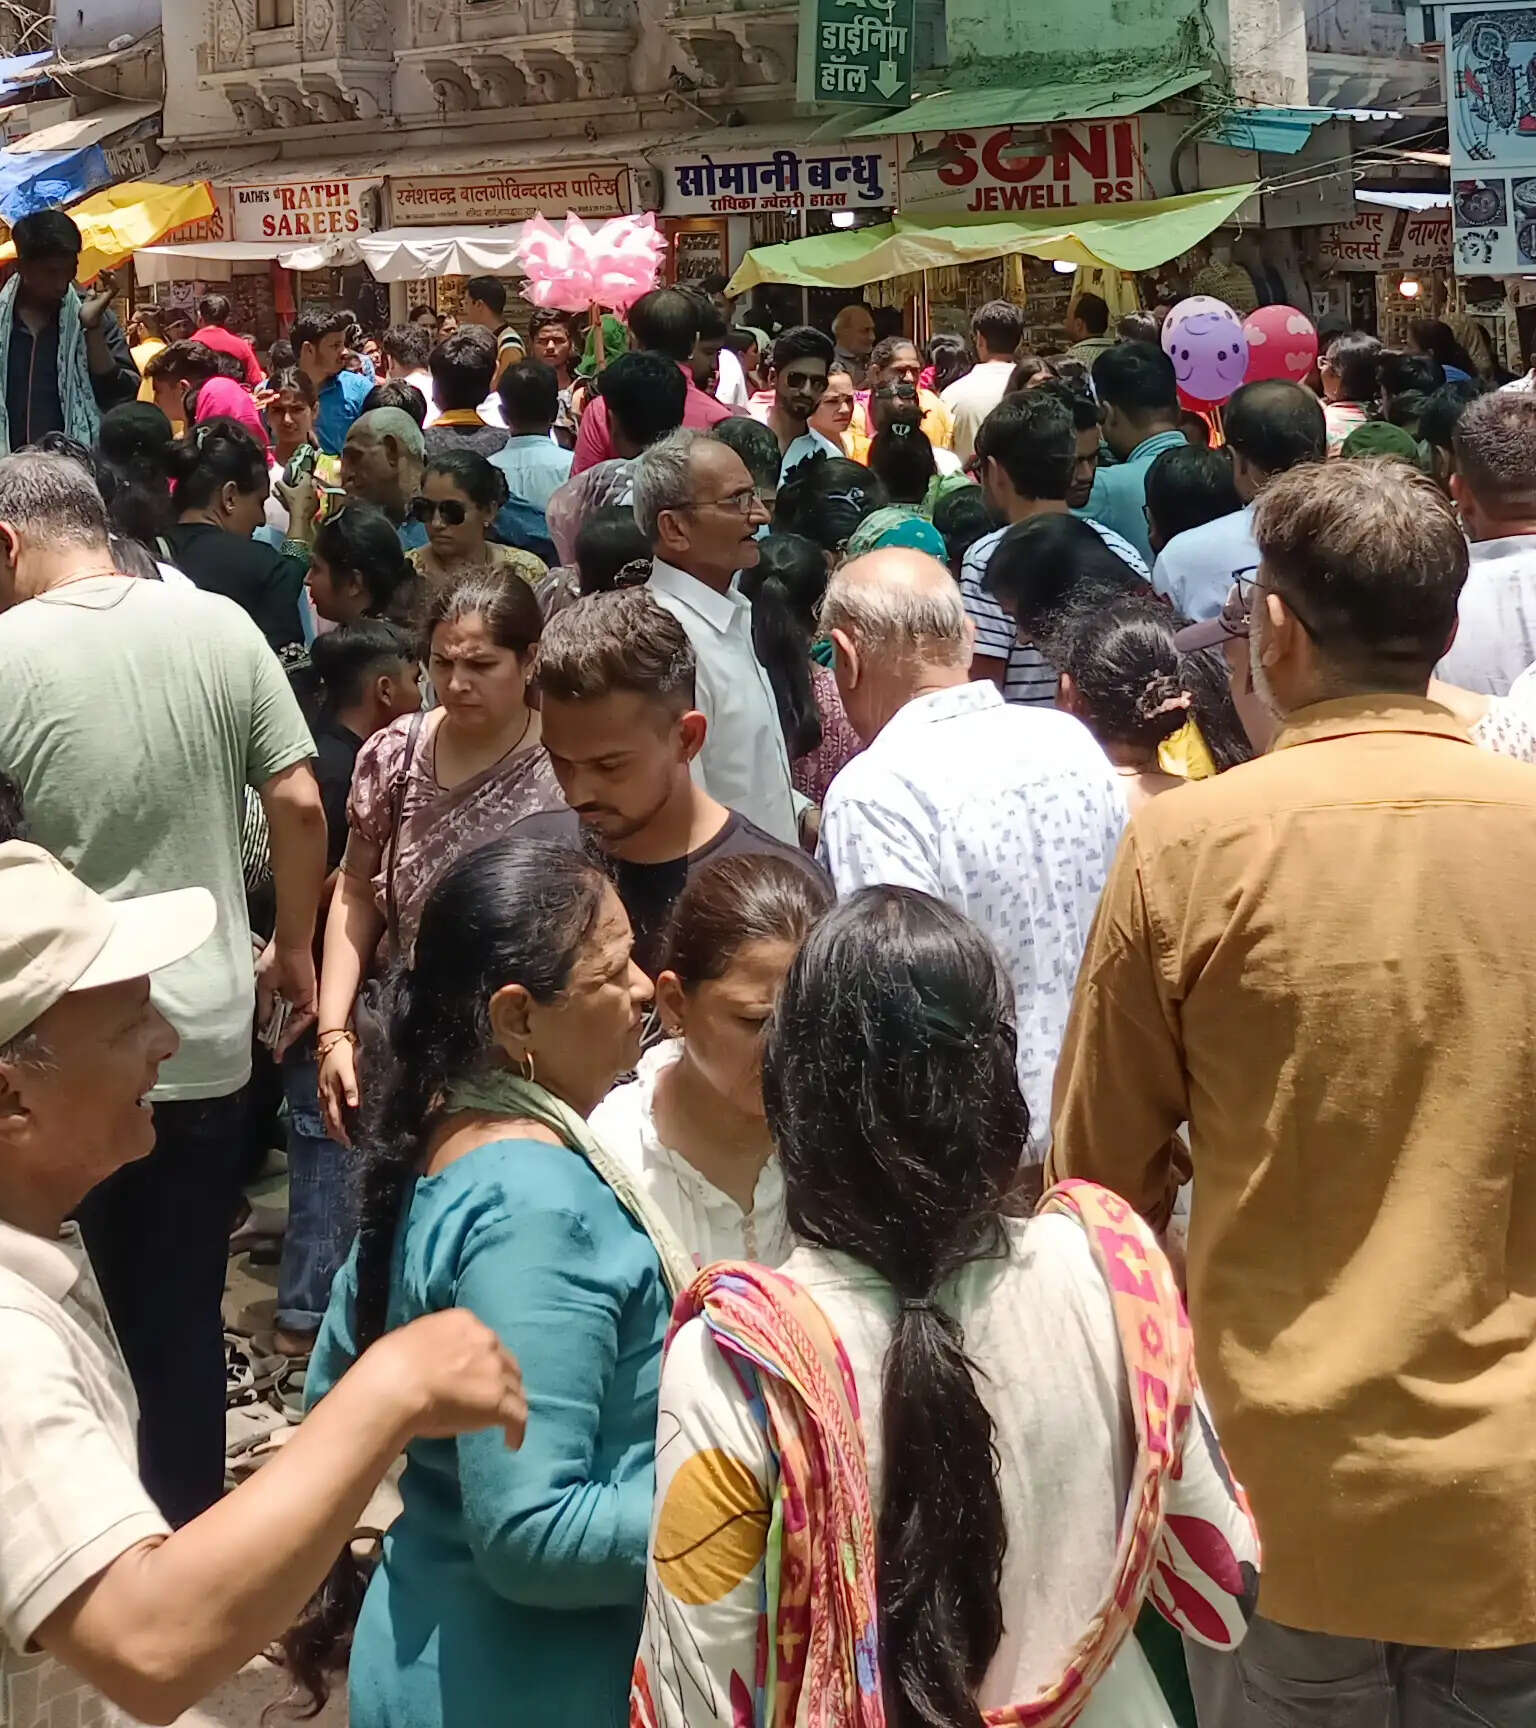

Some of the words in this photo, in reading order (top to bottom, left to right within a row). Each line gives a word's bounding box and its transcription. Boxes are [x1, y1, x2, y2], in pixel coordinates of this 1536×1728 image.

[820, 54, 870, 94] हॉल
[937, 122, 1134, 186] SONI
[674, 150, 802, 196] सोमानी
[805, 153, 884, 200] बन्धु
[281, 182, 351, 210] RATHI
[263, 208, 360, 237] SAREES
